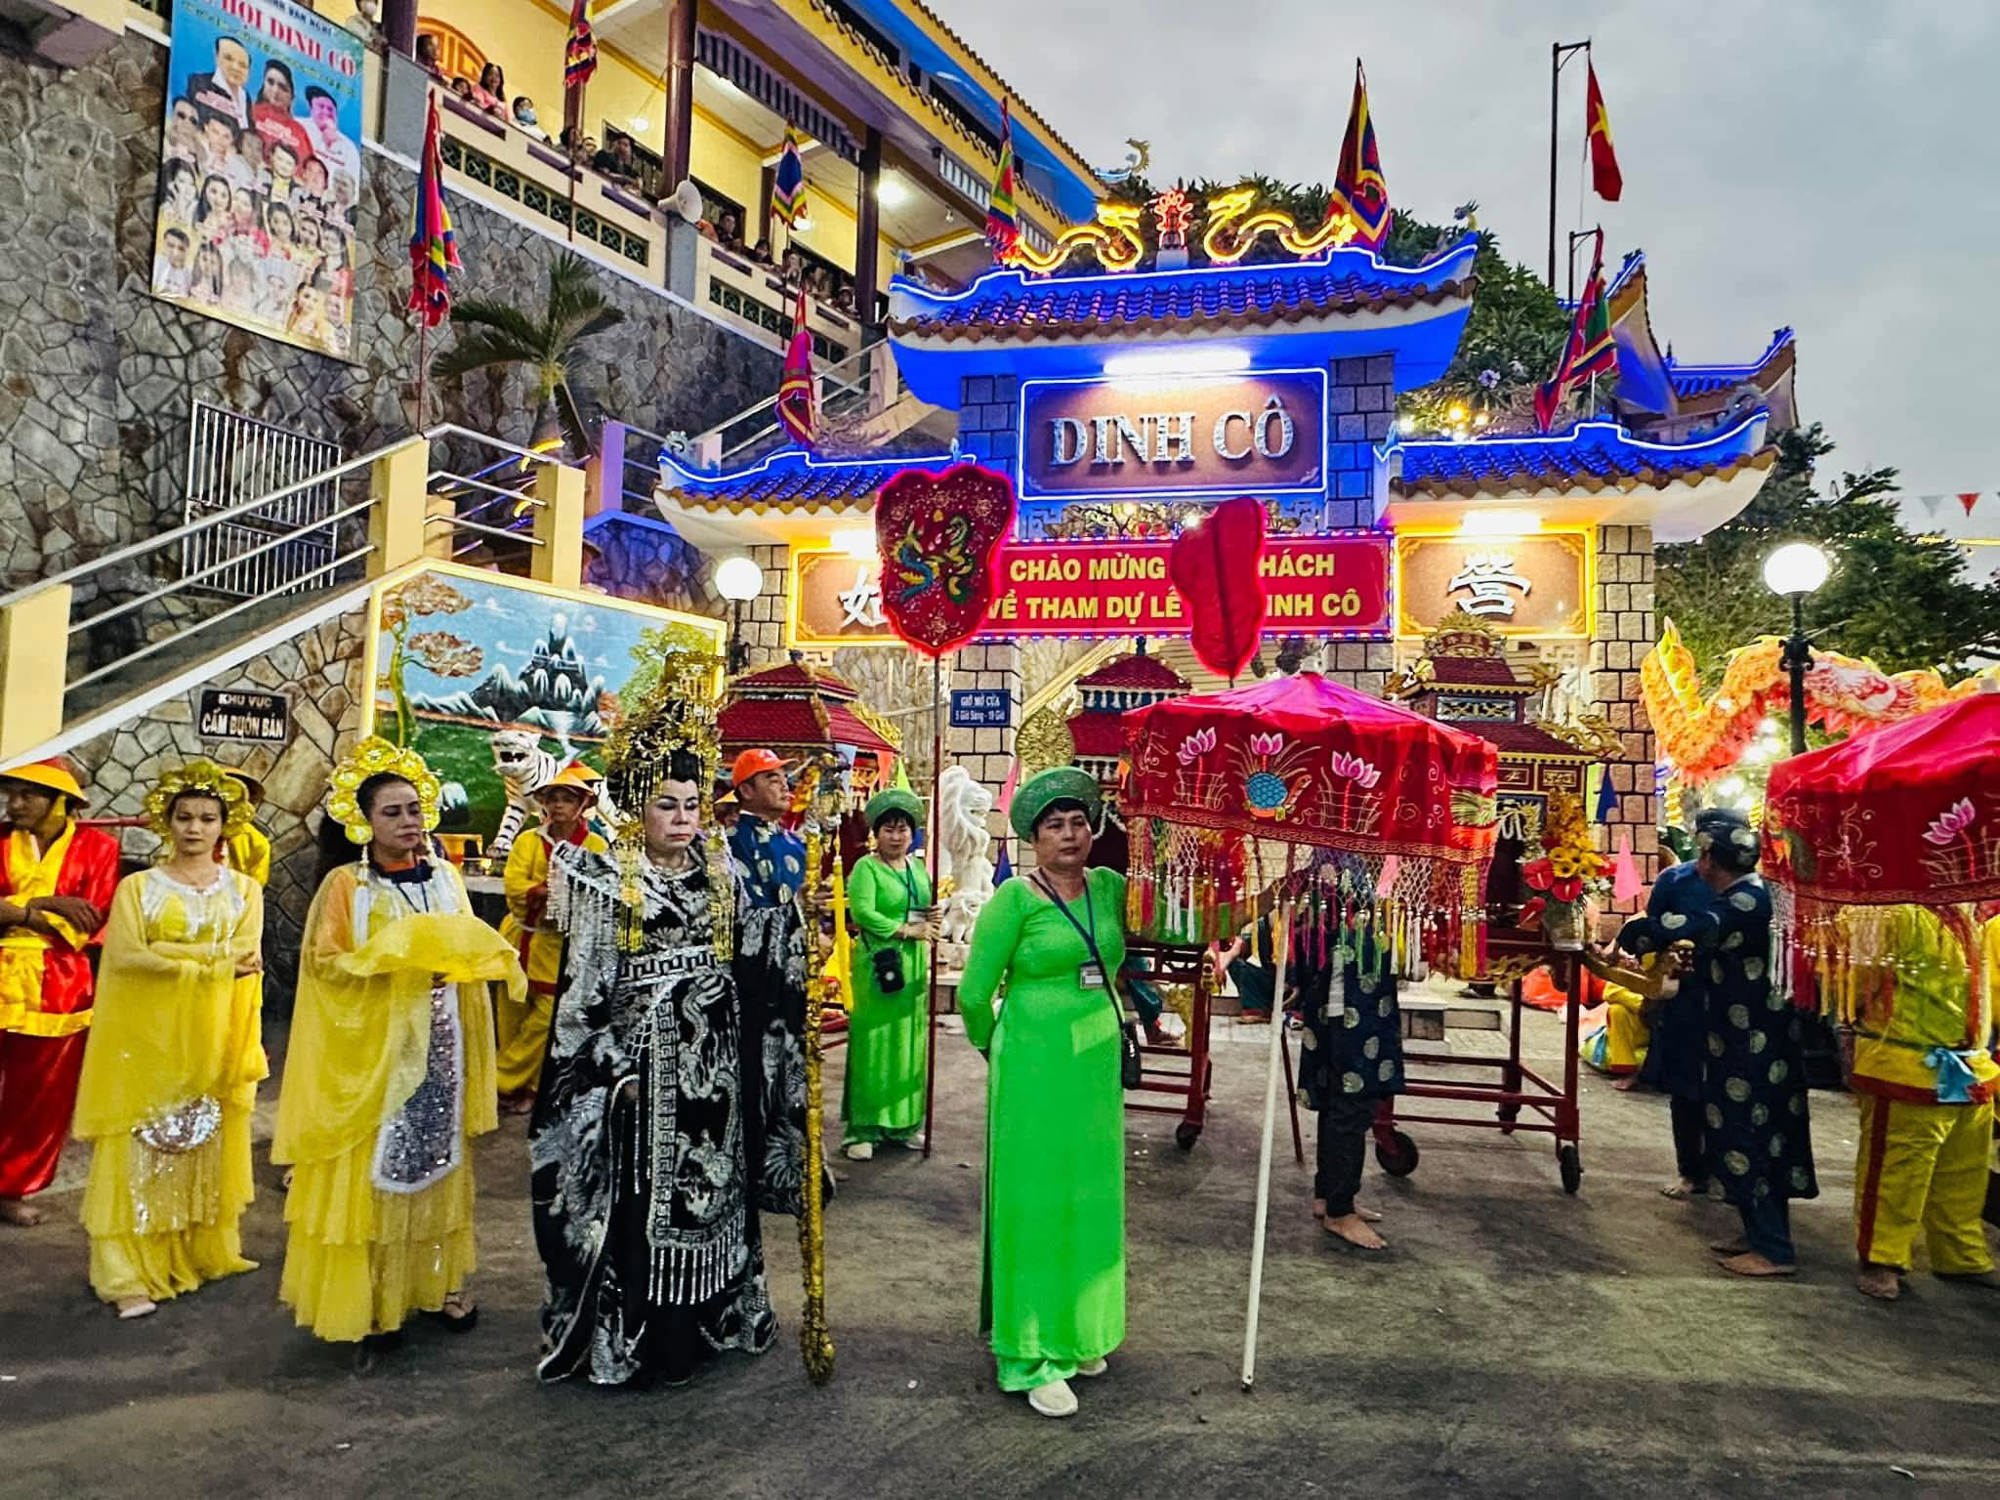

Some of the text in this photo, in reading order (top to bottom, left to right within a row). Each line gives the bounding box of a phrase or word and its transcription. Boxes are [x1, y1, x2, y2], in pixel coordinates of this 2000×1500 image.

[270, 17, 322, 62] DINH
[1049, 395, 1295, 467] DINH CÔ
[1010, 548, 1335, 581] CHÀO MỪNG HÁCH
[1025, 596, 1099, 619] THAM
[1107, 591, 1145, 624] DỰ
[1266, 593, 1314, 617] INH
[1322, 588, 1361, 617] CÔ
[218, 693, 245, 706] KHU
